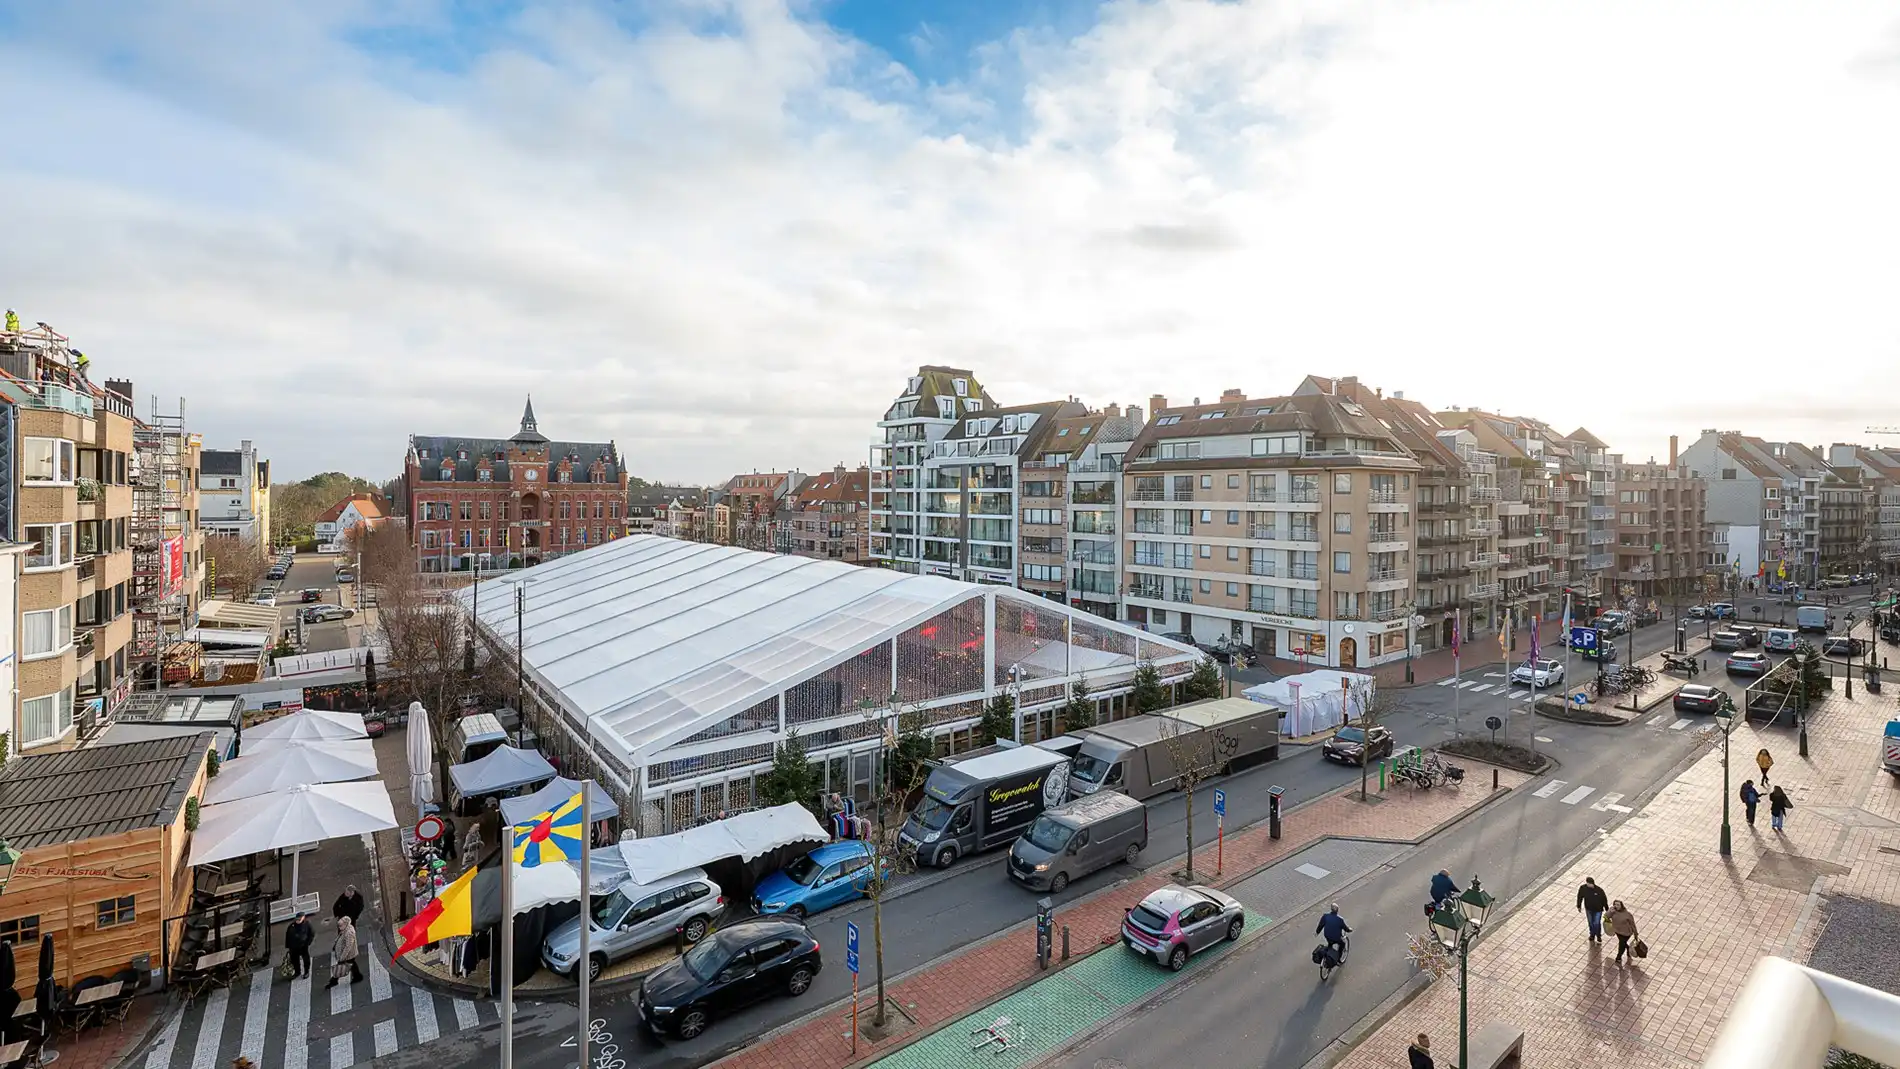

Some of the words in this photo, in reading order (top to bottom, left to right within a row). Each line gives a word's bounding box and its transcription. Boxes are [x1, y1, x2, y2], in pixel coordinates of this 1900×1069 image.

[1583, 632, 1594, 646] P
[1215, 791, 1224, 805] P
[848, 926, 857, 946] P
